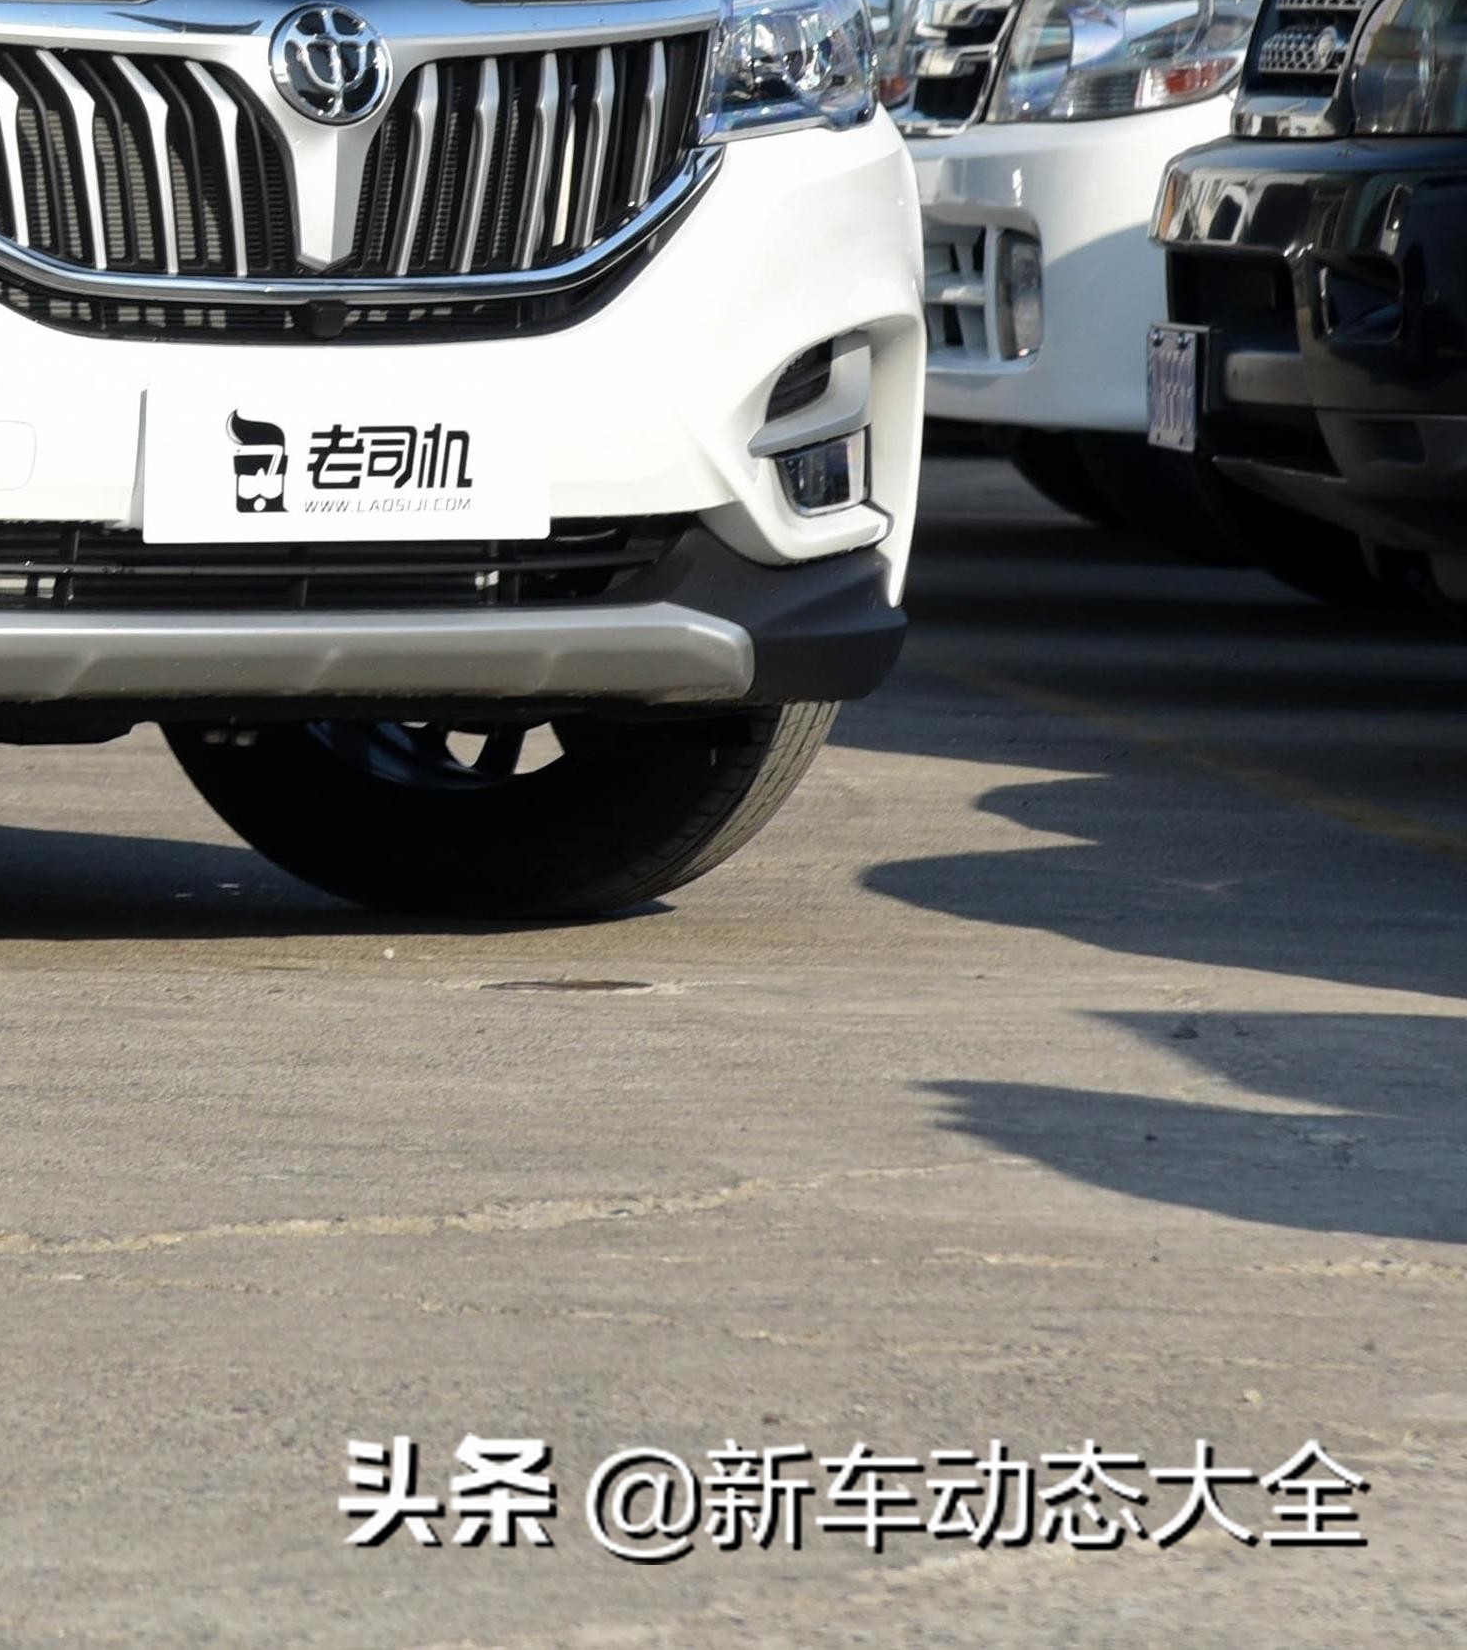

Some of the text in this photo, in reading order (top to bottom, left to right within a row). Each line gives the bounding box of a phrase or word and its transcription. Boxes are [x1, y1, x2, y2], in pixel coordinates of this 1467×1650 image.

[307, 423, 472, 490] 老司机
[304, 497, 472, 513] WWW.LAOSIJI.COM
